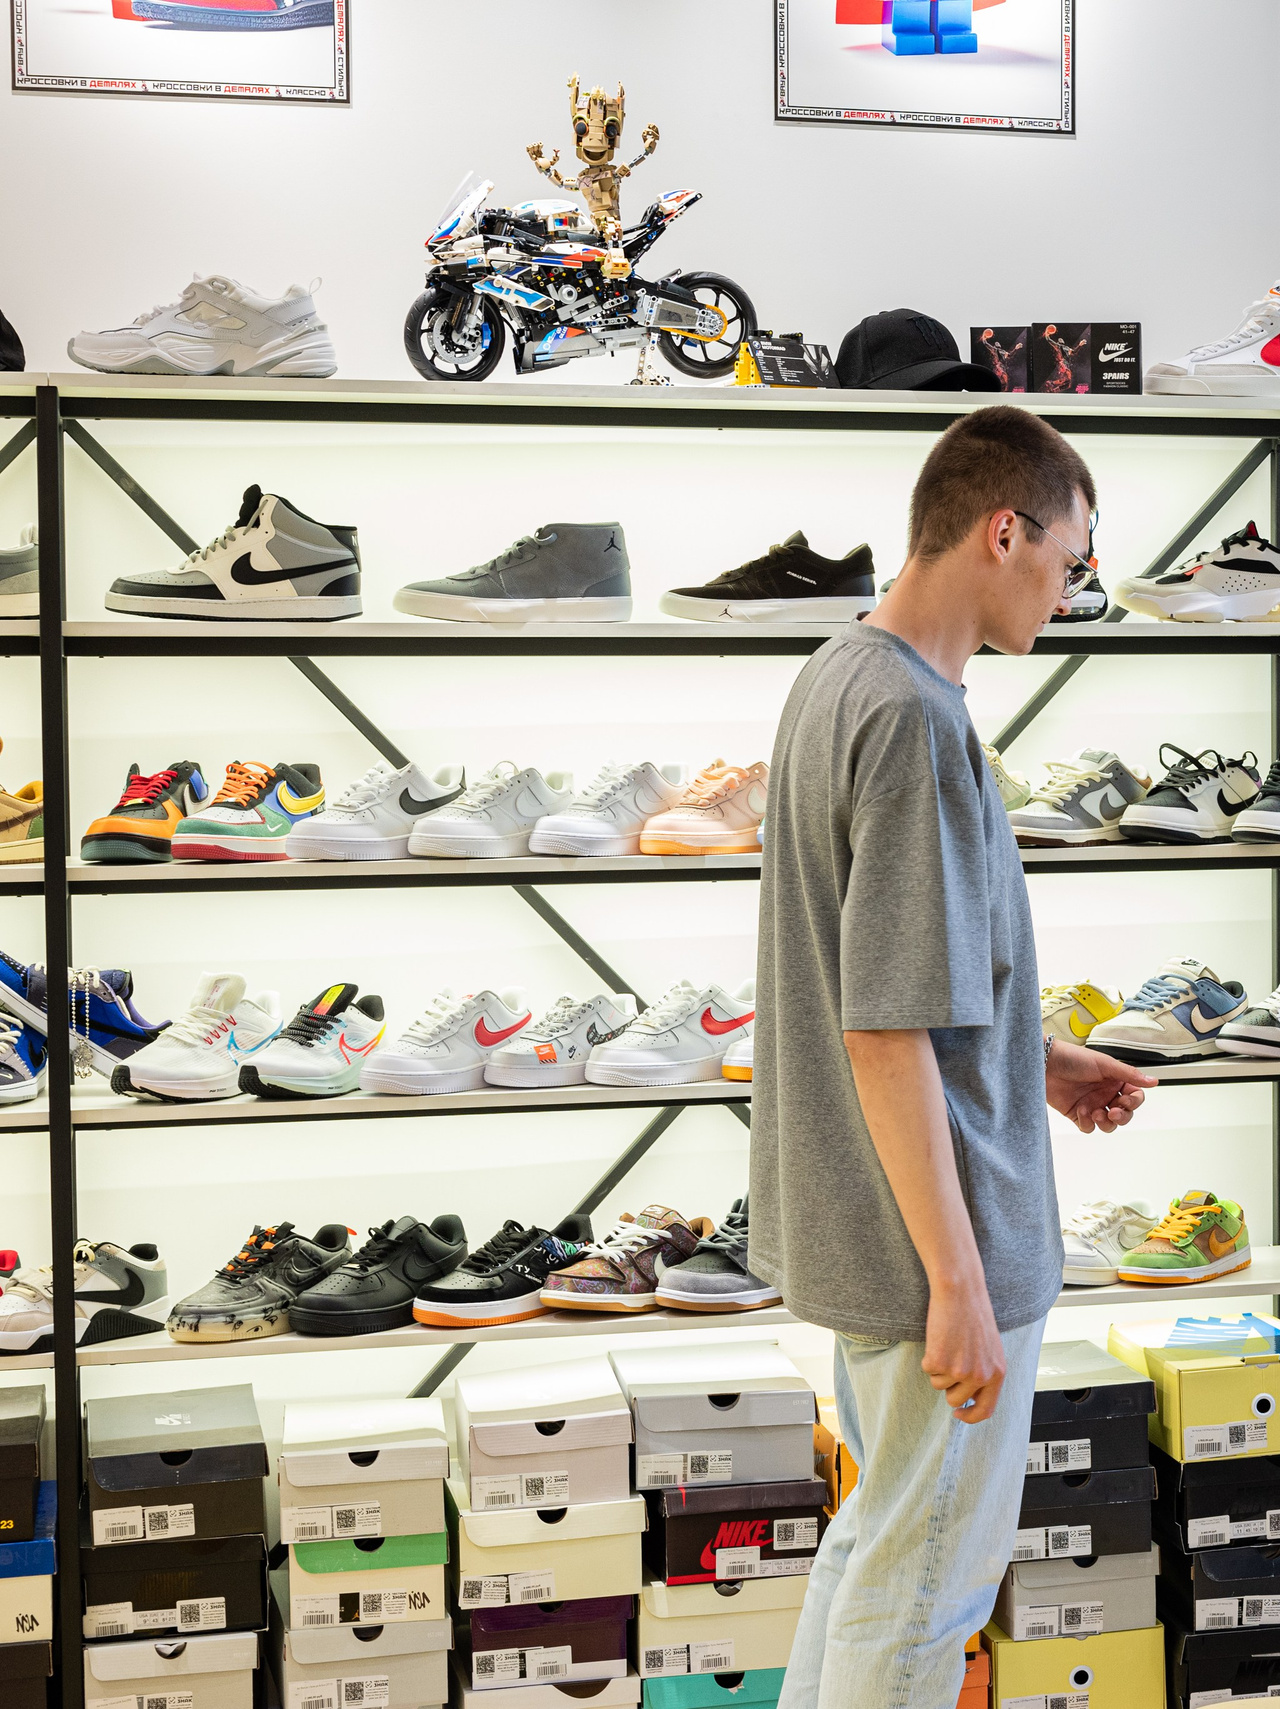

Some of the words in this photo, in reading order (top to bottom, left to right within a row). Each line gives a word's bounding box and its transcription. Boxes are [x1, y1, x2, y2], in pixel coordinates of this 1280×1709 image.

[17, 77, 78, 87] КРОССОВКИ
[80, 79, 87, 87] В
[89, 79, 137, 89] ДЕТАЛЯХ
[152, 82, 213, 92] КРОССОВКИ
[224, 86, 271, 94] ДЕТАЛЯХ
[286, 88, 326, 97] КЛАССНО
[779, 108, 834, 117] КРОССОВКИ
[835, 110, 842, 118] В
[844, 111, 886, 120] ДЕТАЛЯХ
[899, 114, 953, 122] КРОССОВКИ
[963, 117, 1005, 126] ДЕТАЛЯХ
[1104, 342, 1126, 351] NIKE
[1102, 372, 1130, 380] 3PAIRS
[713, 1519, 770, 1549] NIKE
